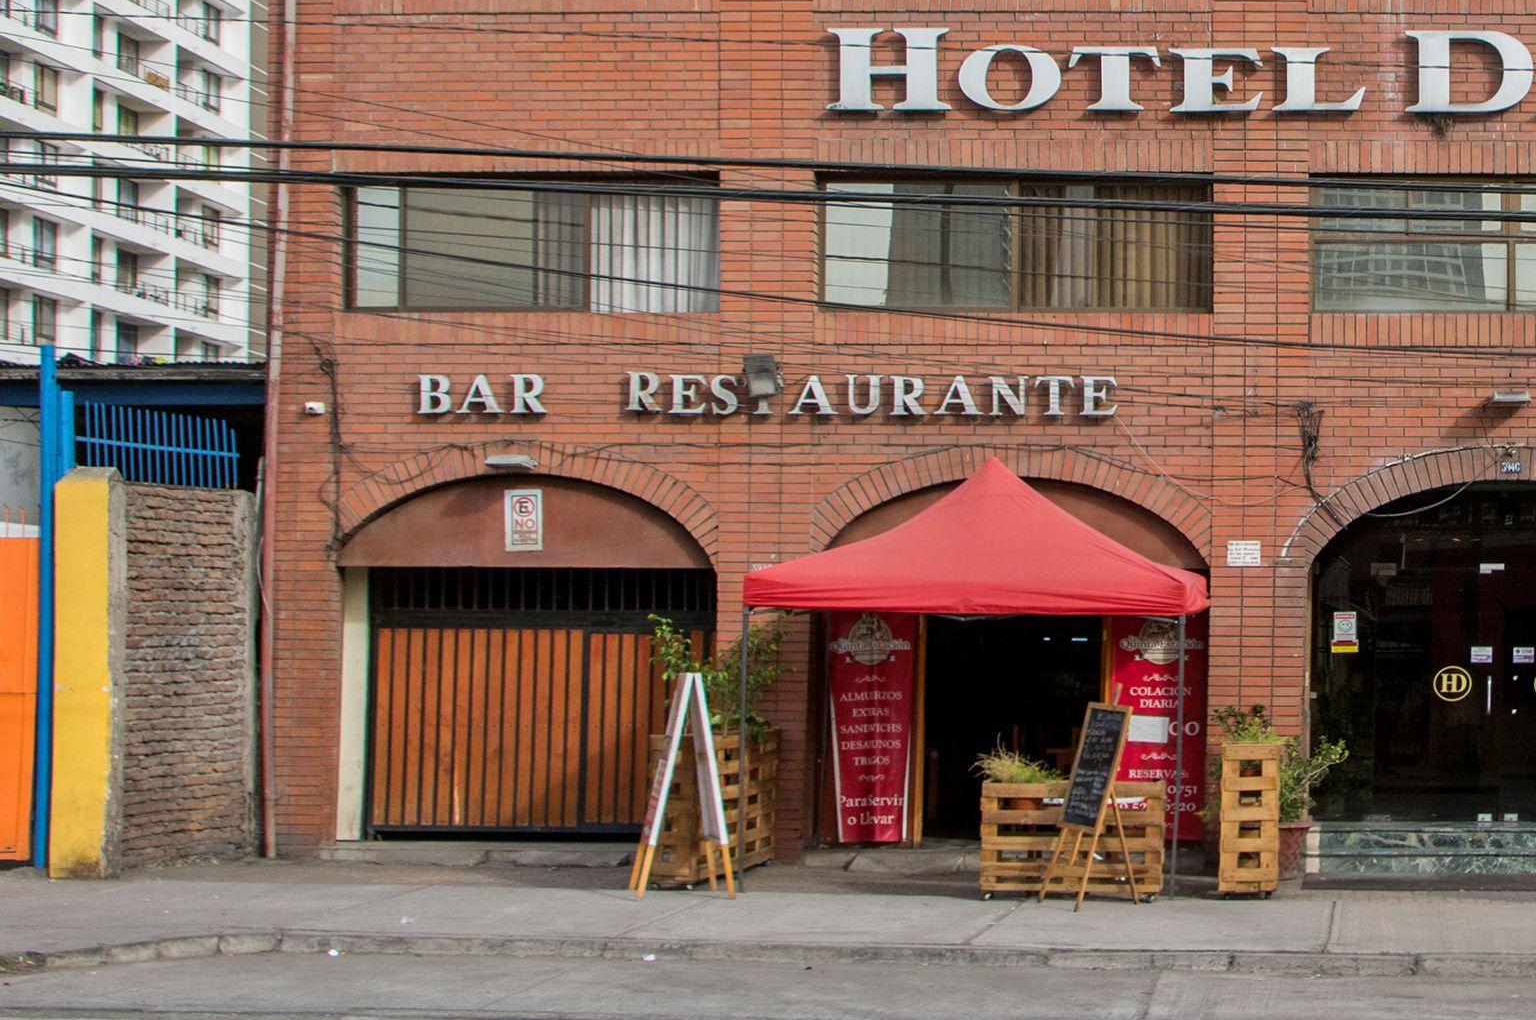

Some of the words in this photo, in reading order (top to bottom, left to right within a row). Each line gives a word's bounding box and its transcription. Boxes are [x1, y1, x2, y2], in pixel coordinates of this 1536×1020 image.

[826, 28, 1366, 113] HOTEL
[418, 374, 547, 414] BAR
[515, 519, 535, 529] NO
[840, 691, 902, 702] ALMUERZOS
[852, 707, 889, 717] EXTRAS
[847, 816, 857, 826] o
